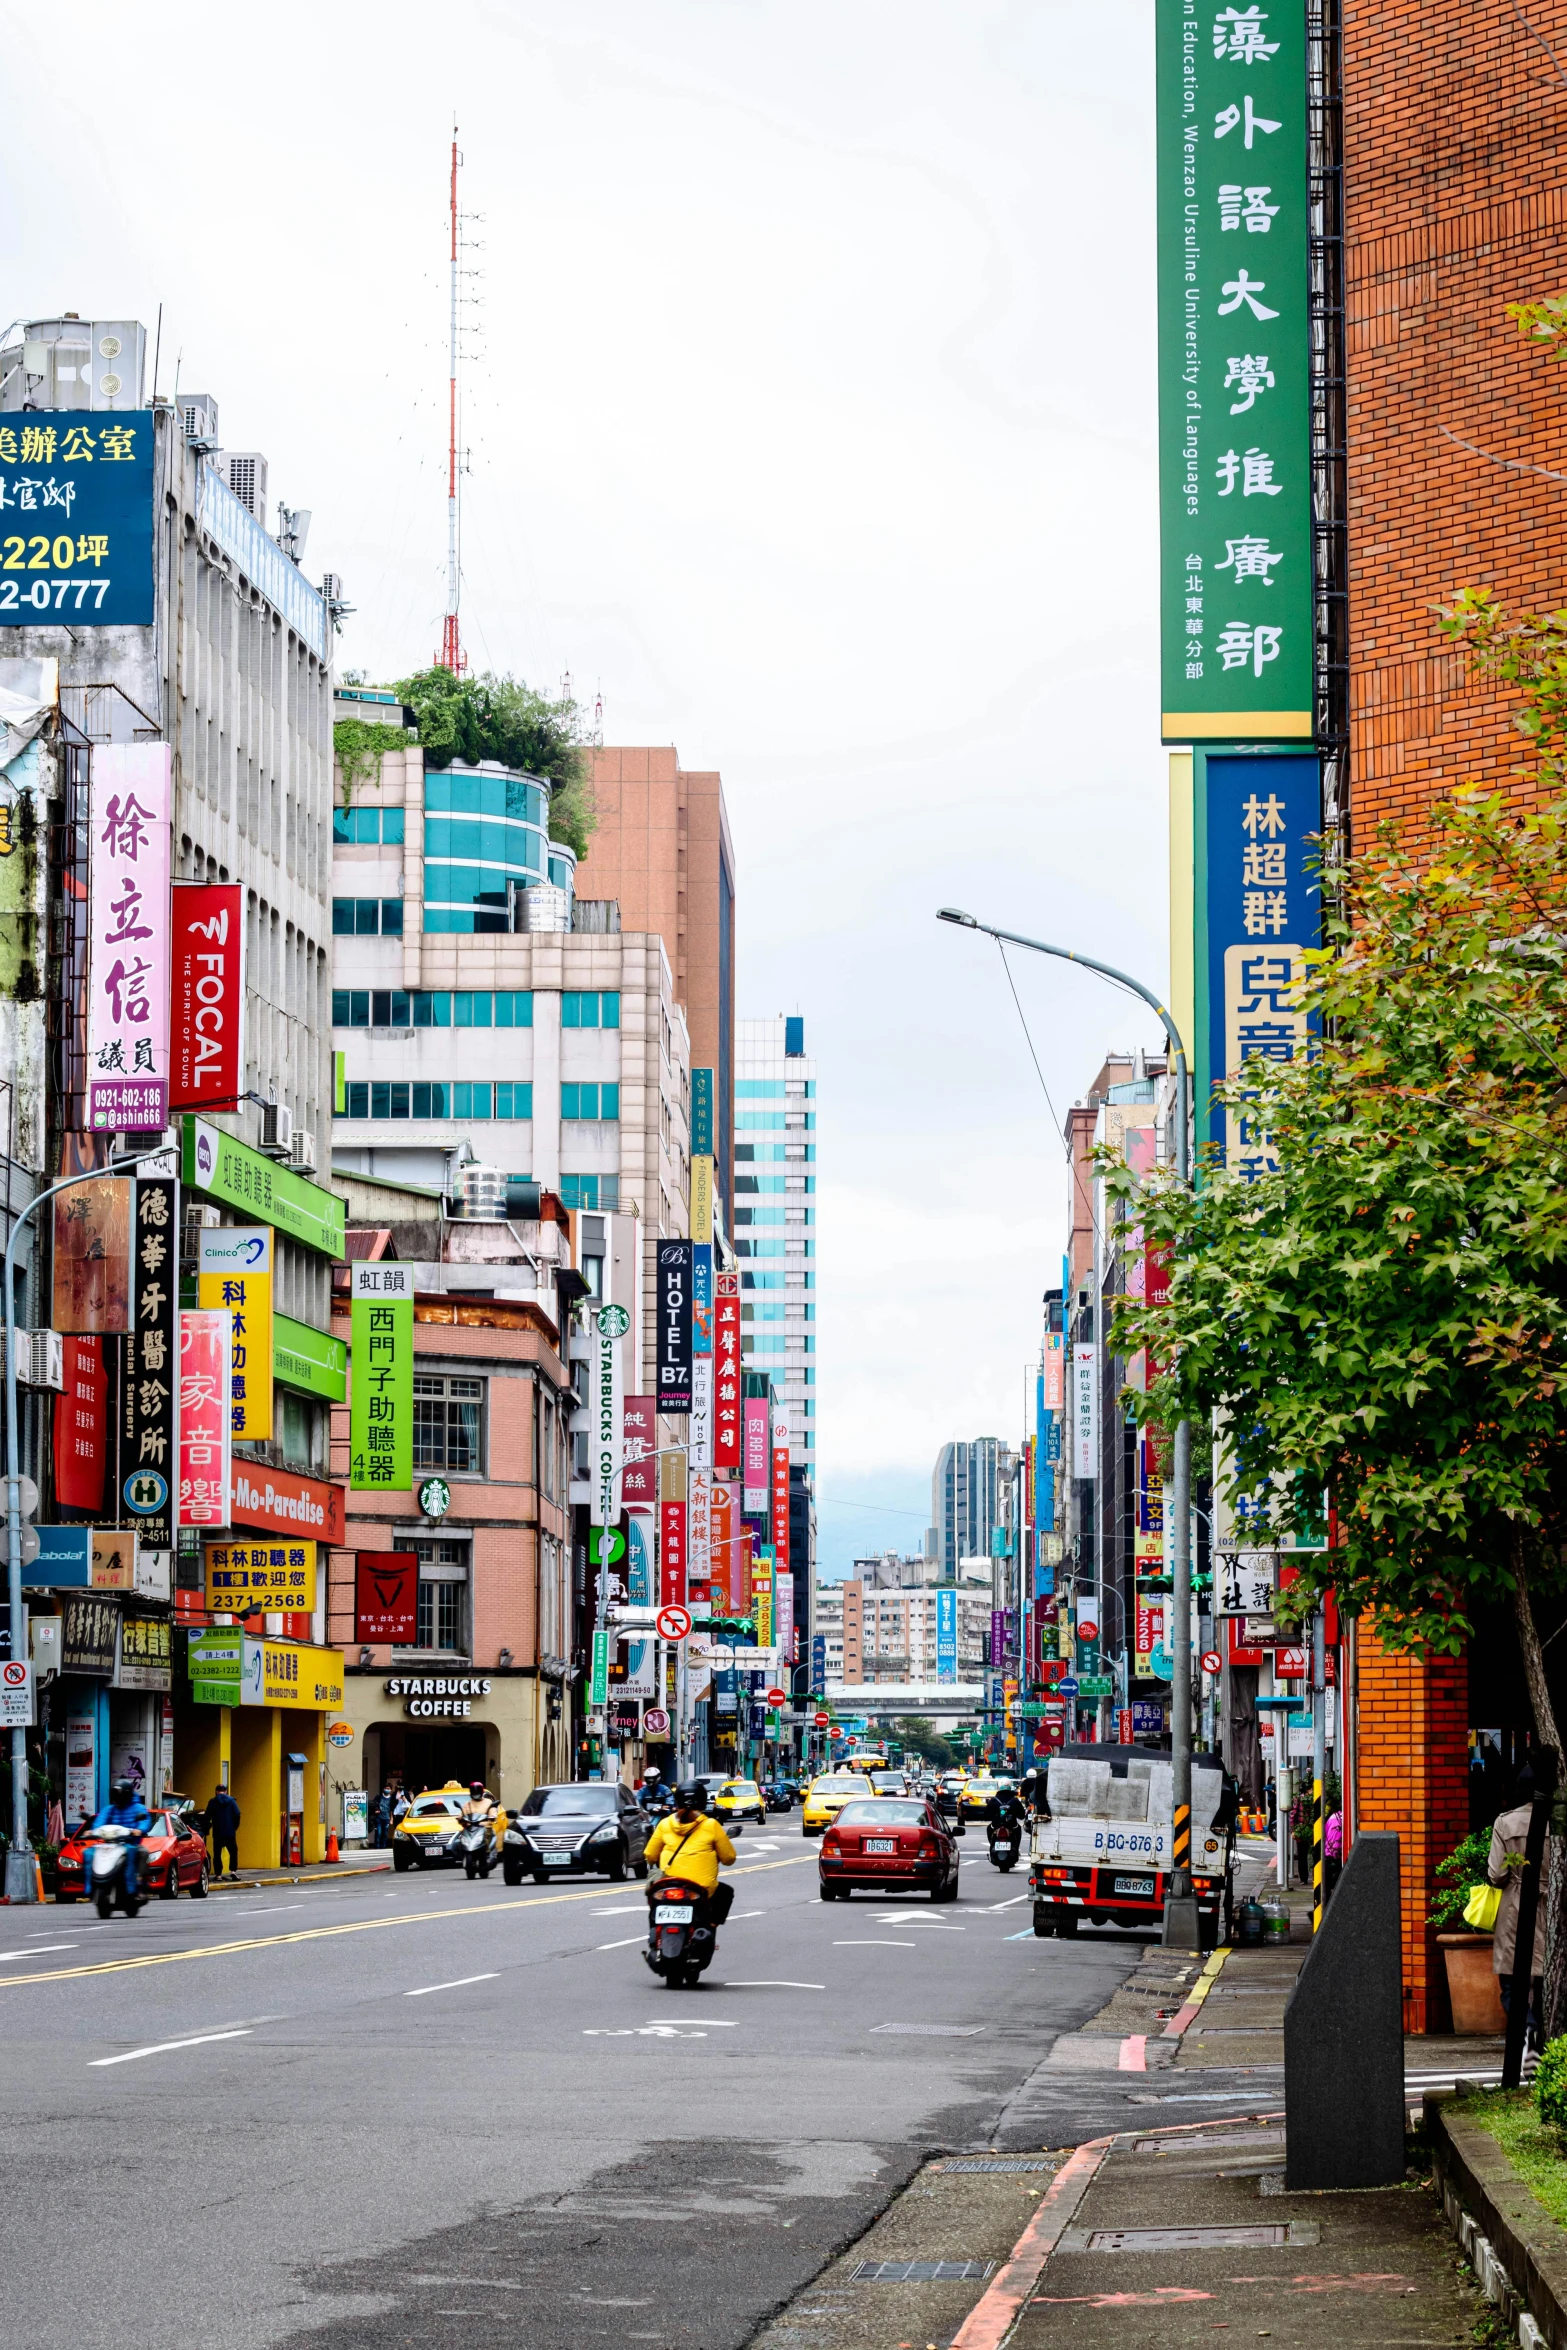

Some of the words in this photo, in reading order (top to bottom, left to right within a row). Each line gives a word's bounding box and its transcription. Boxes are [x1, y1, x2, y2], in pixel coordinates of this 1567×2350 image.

[1182, 21, 1198, 119] Education,
[1183, 125, 1199, 197] Wenzao
[1184, 204, 1200, 282] Ursuline
[1185, 288, 1201, 383] University
[1213, 4, 1283, 678] 藻外語大學推廣部
[1186, 390, 1202, 409] of
[1182, 415, 1201, 516] Languages
[1185, 553, 1204, 680] 台北東華分部
[1242, 793, 1288, 936] 林超群
[101, 792, 157, 1025] 徐立信
[184, 954, 192, 979] THE
[184, 982, 192, 1022] SPIRIT
[183, 1027, 191, 1042] OF
[193, 953, 225, 1088] FOCAL
[95, 1038, 157, 1074] 議員
[181, 1047, 190, 1088] SOUND
[95, 1087, 161, 1108] 0921-602-186
[107, 1108, 161, 1128] @ashin666
[697, 1165, 706, 1202] FINDERS
[696, 1204, 706, 1232] HOTEL
[205, 1248, 238, 1257] Clinico
[359, 1270, 405, 1291] 虹韻
[139, 1187, 169, 1464] 德華牙醫診所
[667, 1273, 683, 1362] HOTEL
[600, 1340, 612, 1442] STARBUCKS
[661, 1367, 687, 1383] B7
[718, 1306, 737, 1448] 正聲廣播公司
[126, 1383, 135, 1439] Surgery
[367, 1307, 396, 1482] 西門子助聽器
[658, 1391, 691, 1400] Journey
[353, 1453, 366, 1482] 4樓
[691, 1473, 709, 1541] 大新銀樓
[749, 1499, 762, 1508] 3F
[1149, 1521, 1162, 1529] 9F
[212, 1549, 306, 1567] 科林助聽器
[218, 1572, 244, 1586] 1樓
[251, 1571, 306, 1587] 歡迎您
[66, 1602, 117, 1647] 德華牙醫診所
[123, 1619, 170, 1656] 行家音響
[190, 1666, 239, 1675] 02-2382-1222
[205, 1650, 234, 1659] 請上4樓
[265, 1651, 298, 1681] 科林助聽器
[389, 1679, 492, 1695] STARBUCKS
[409, 1700, 471, 1716] COFFEE
[1141, 1721, 1155, 1729] 9F
[1095, 1833, 1163, 1852] BBQ-8763
[1206, 1841, 1218, 1851] 65
